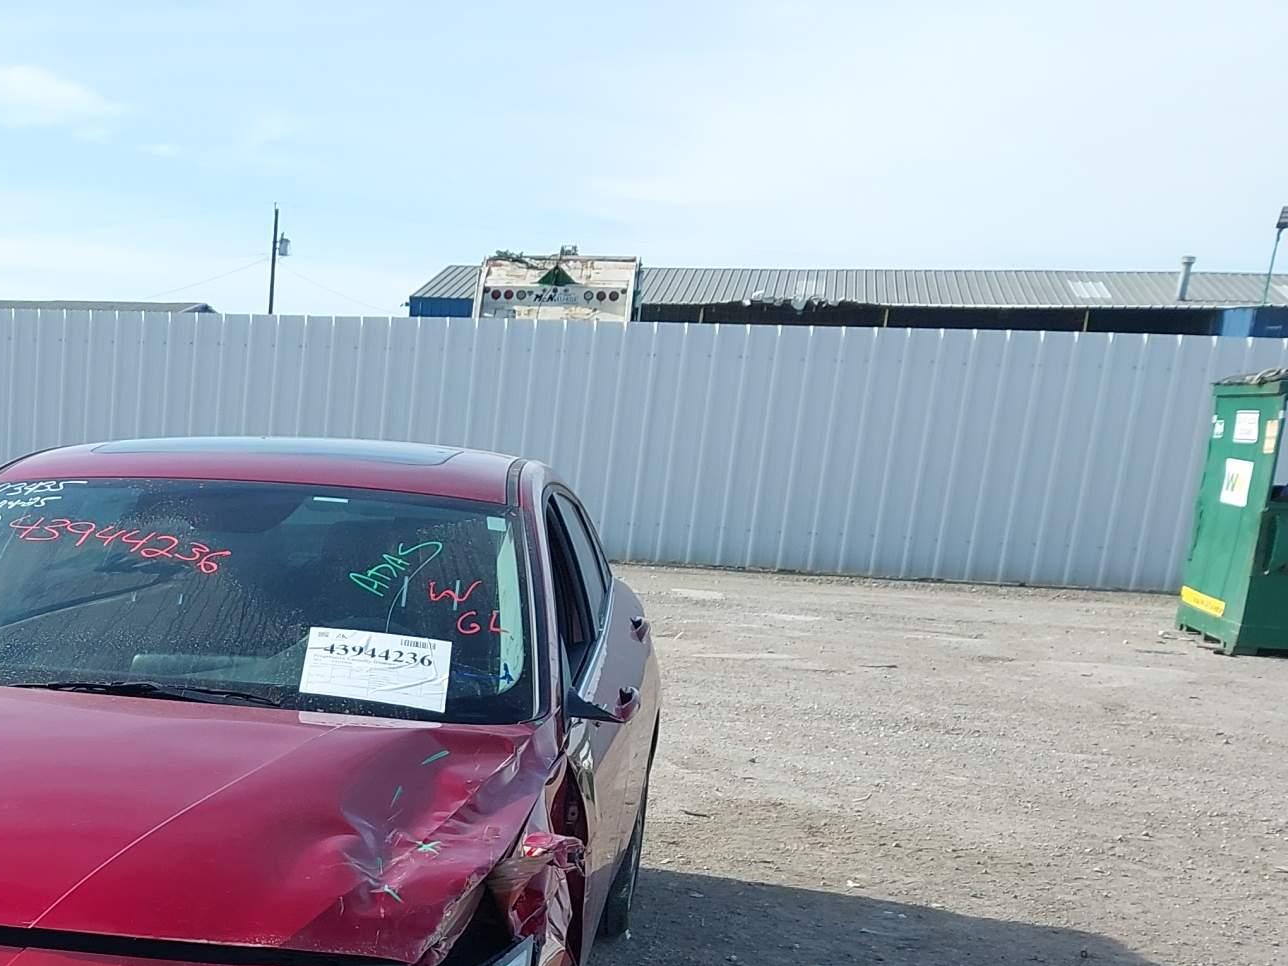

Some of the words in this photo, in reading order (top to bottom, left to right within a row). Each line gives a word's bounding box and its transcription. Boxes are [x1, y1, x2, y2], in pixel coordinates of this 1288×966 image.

[8, 514, 232, 574] 43944236
[348, 541, 443, 597] ADAS
[322, 643, 433, 667] 43944236
